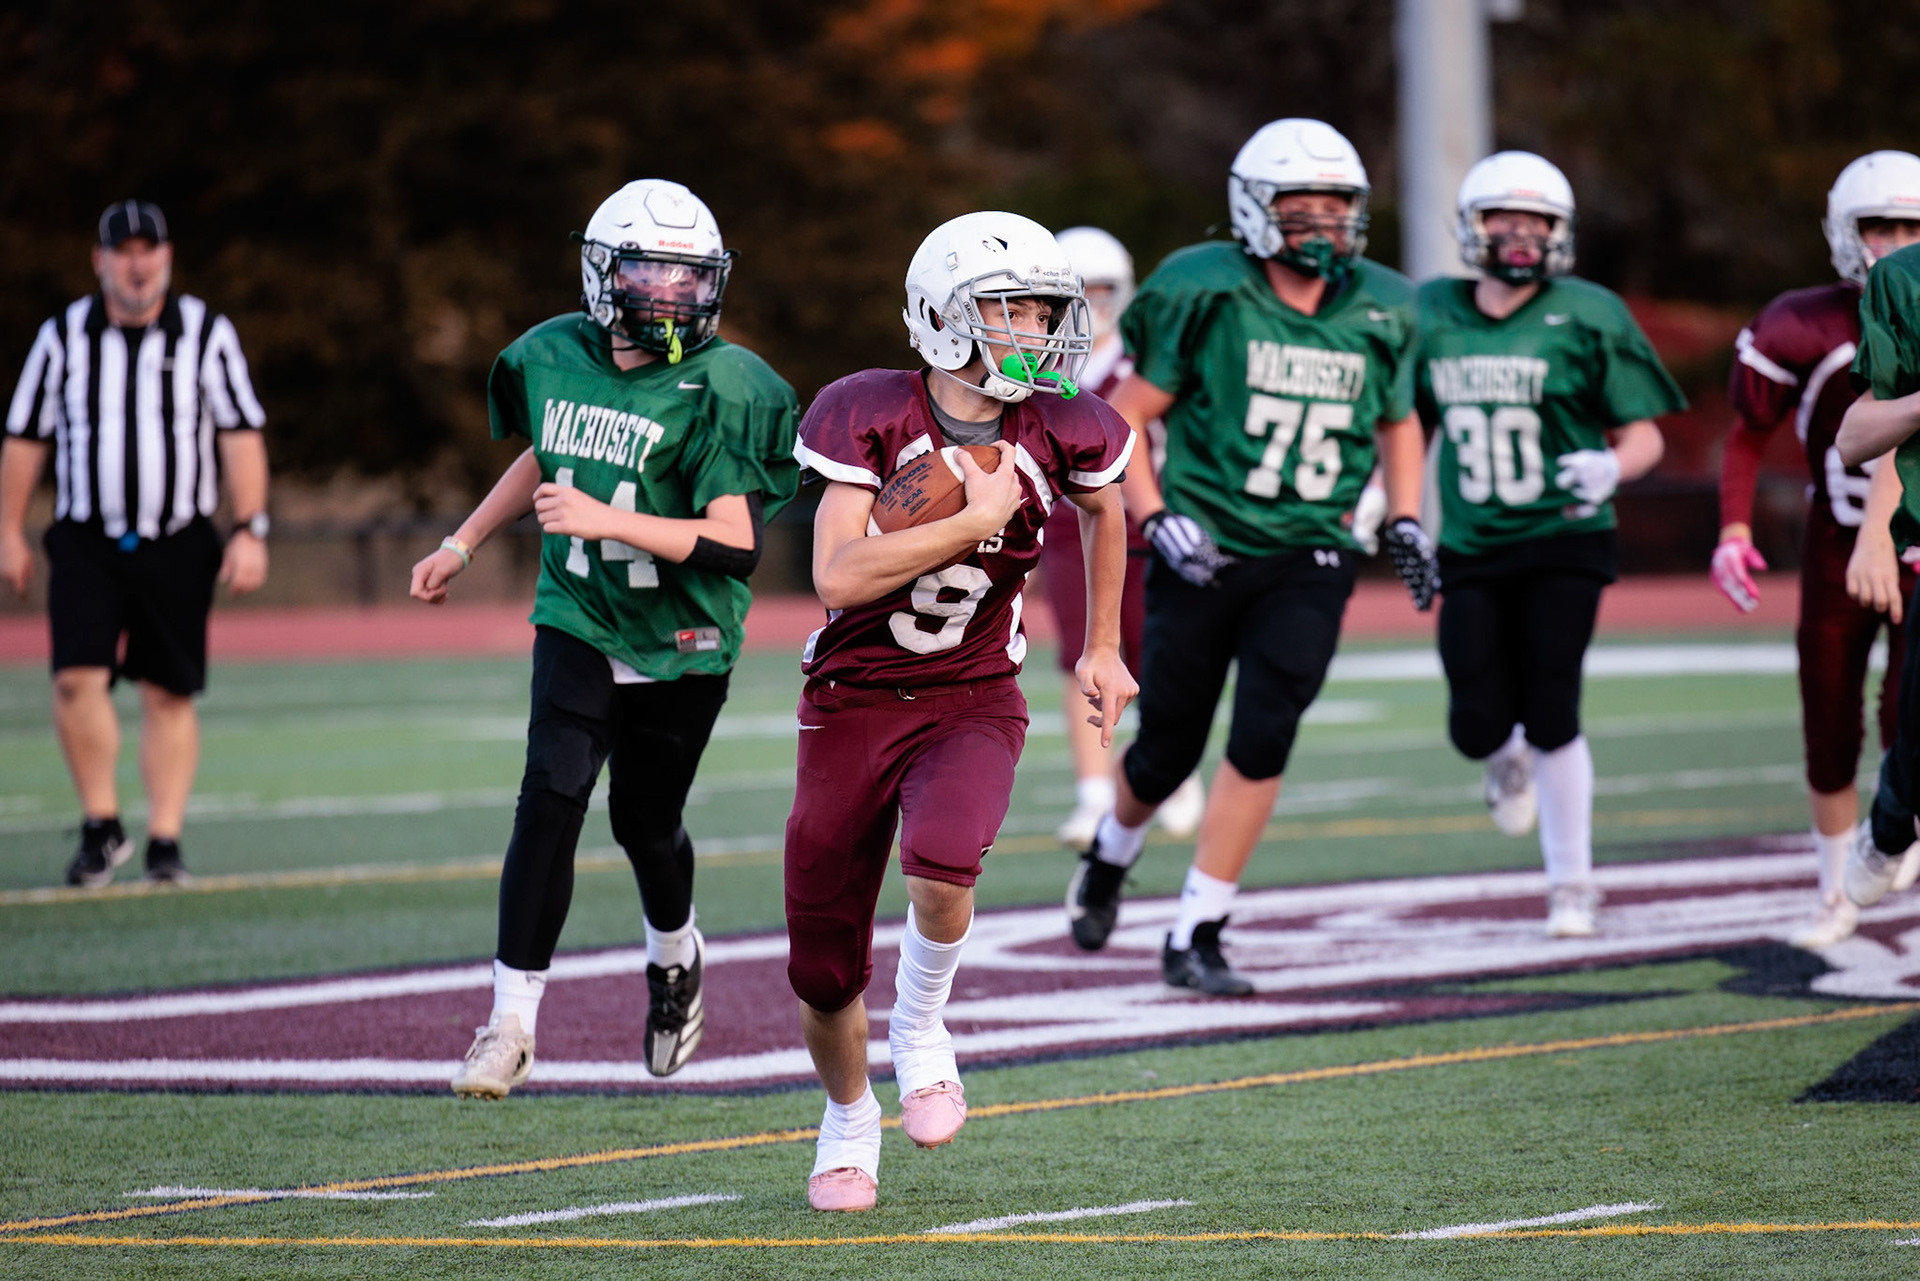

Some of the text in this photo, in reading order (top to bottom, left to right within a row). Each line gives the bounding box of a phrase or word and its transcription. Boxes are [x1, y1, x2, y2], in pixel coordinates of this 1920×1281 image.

[1246, 339, 1367, 401] WACHUSETT
[1429, 354, 1550, 405] WACHUSETT
[541, 398, 666, 474] WACHUSETT
[1244, 393, 1354, 501] 75
[1444, 405, 1547, 506] 30
[555, 466, 660, 588] 14
[901, 488, 924, 510] NCAA
[888, 563, 993, 655] 9
